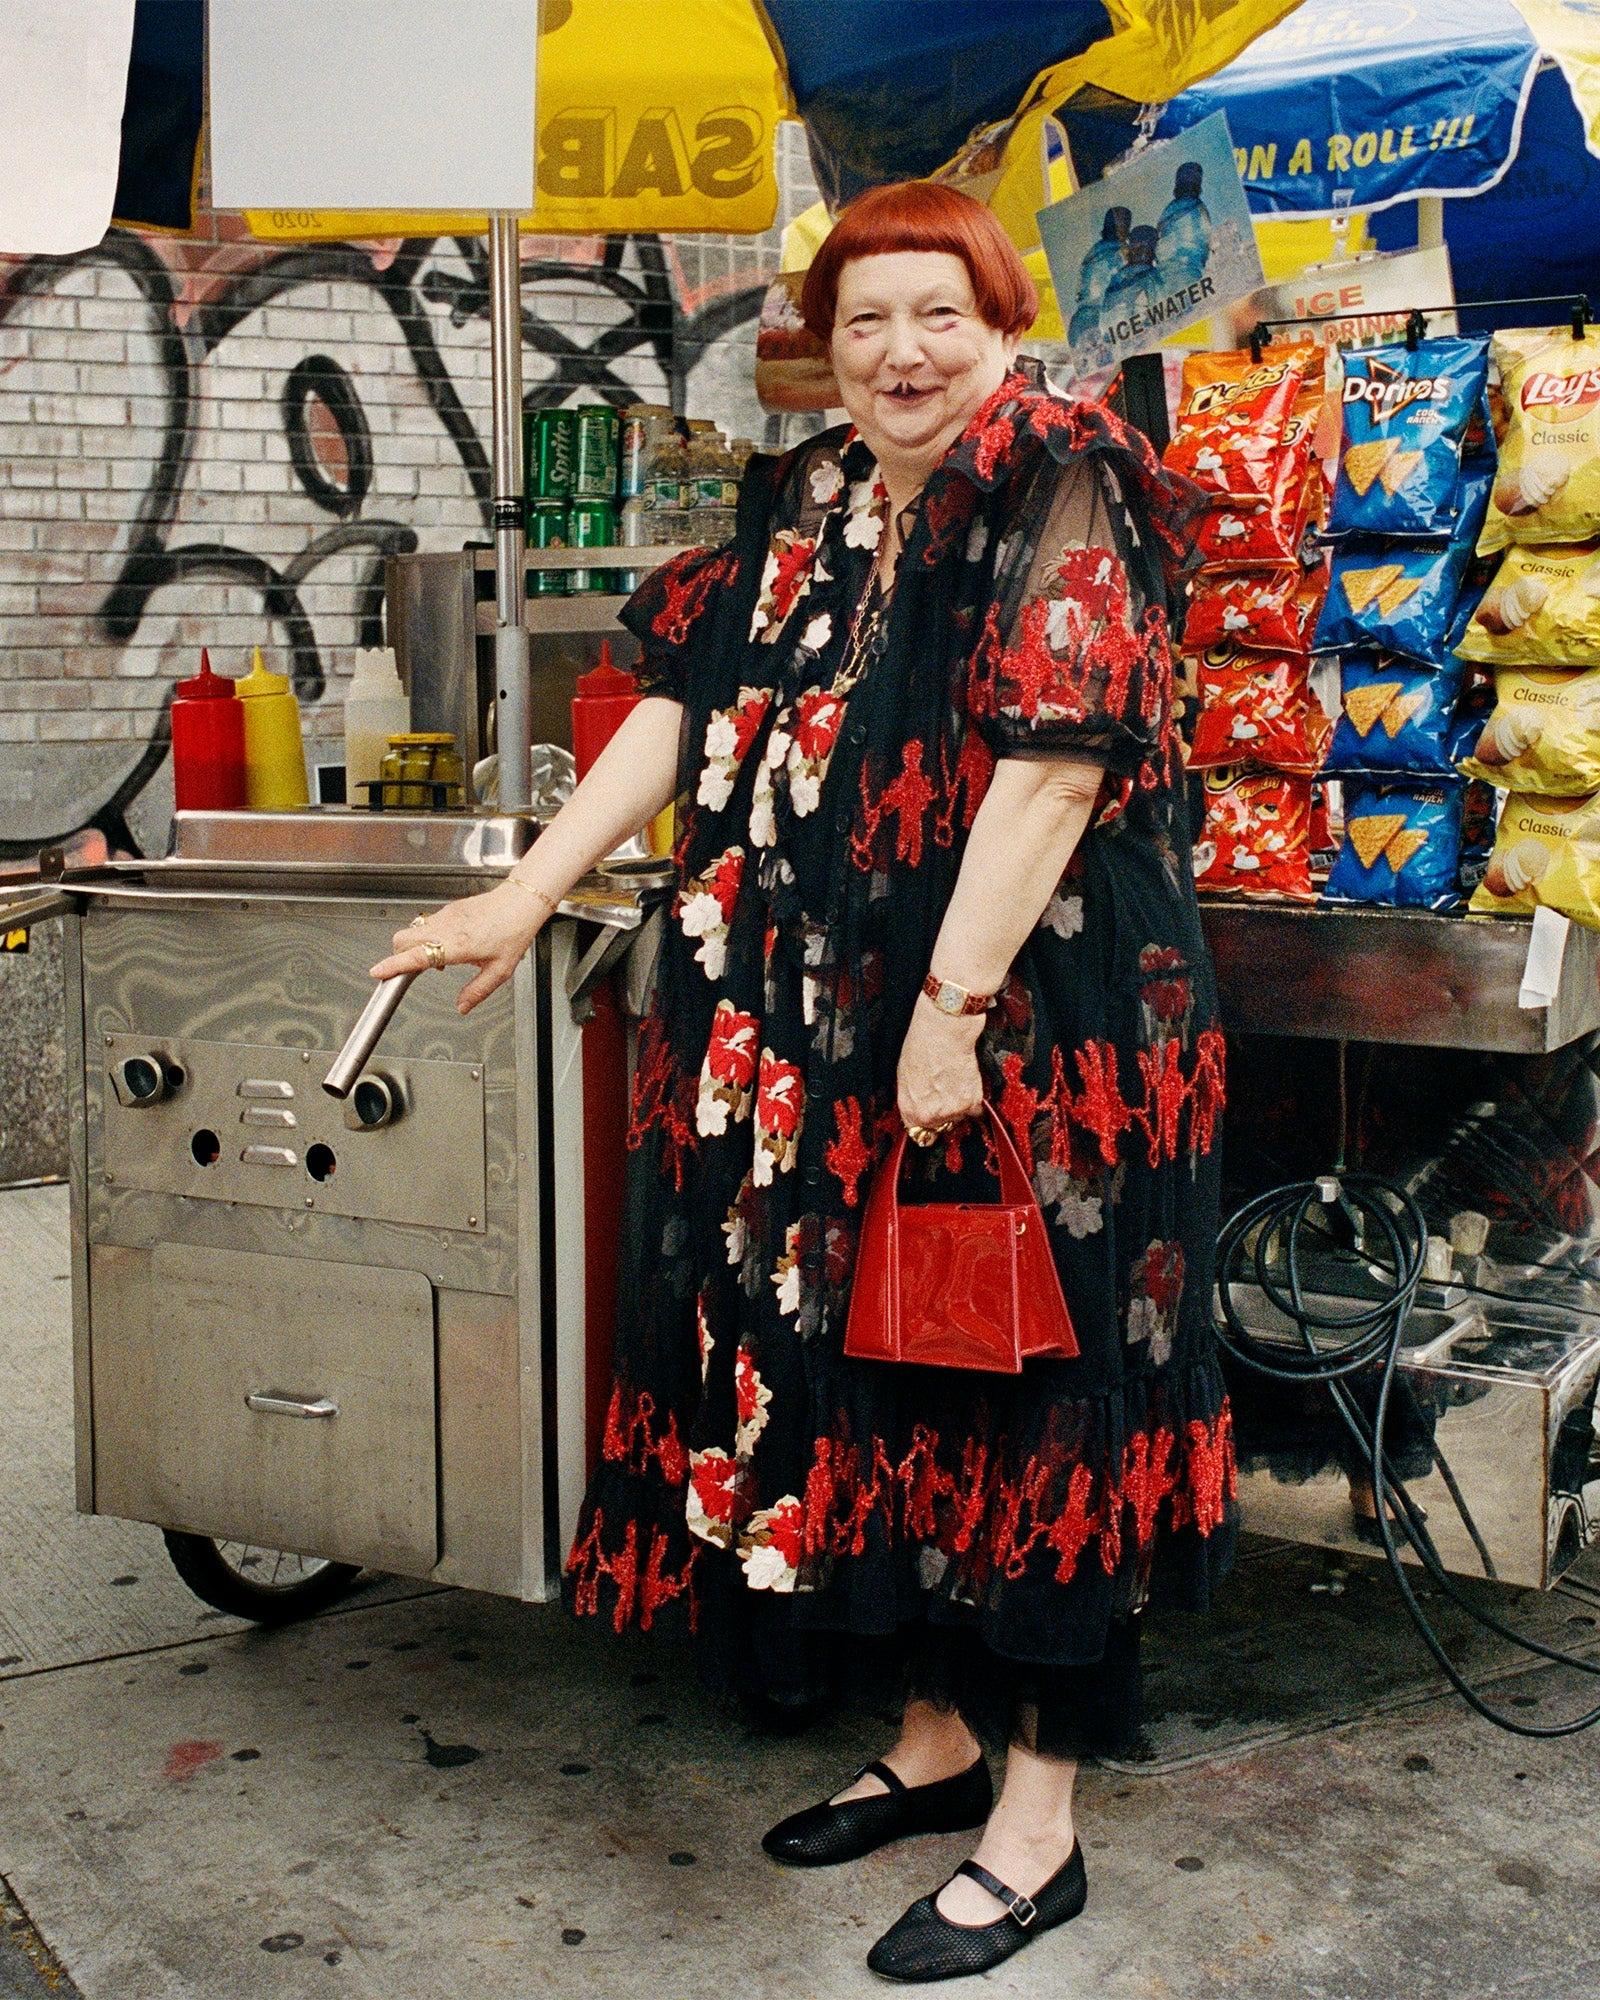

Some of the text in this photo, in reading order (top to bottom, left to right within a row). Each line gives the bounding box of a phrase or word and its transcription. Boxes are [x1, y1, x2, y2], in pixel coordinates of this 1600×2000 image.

[1287, 138, 1313, 177] A
[1326, 124, 1417, 173] ROLL
[1428, 113, 1476, 151] !!!
[1108, 276, 1216, 345] ICE WATER
[1294, 284, 1365, 318] ICE
[1531, 428, 1590, 446] Classic
[550, 420, 573, 483] Sprite
[1520, 562, 1575, 578] Classic
[1513, 687, 1569, 706] Classic
[1518, 816, 1572, 839] Classic
